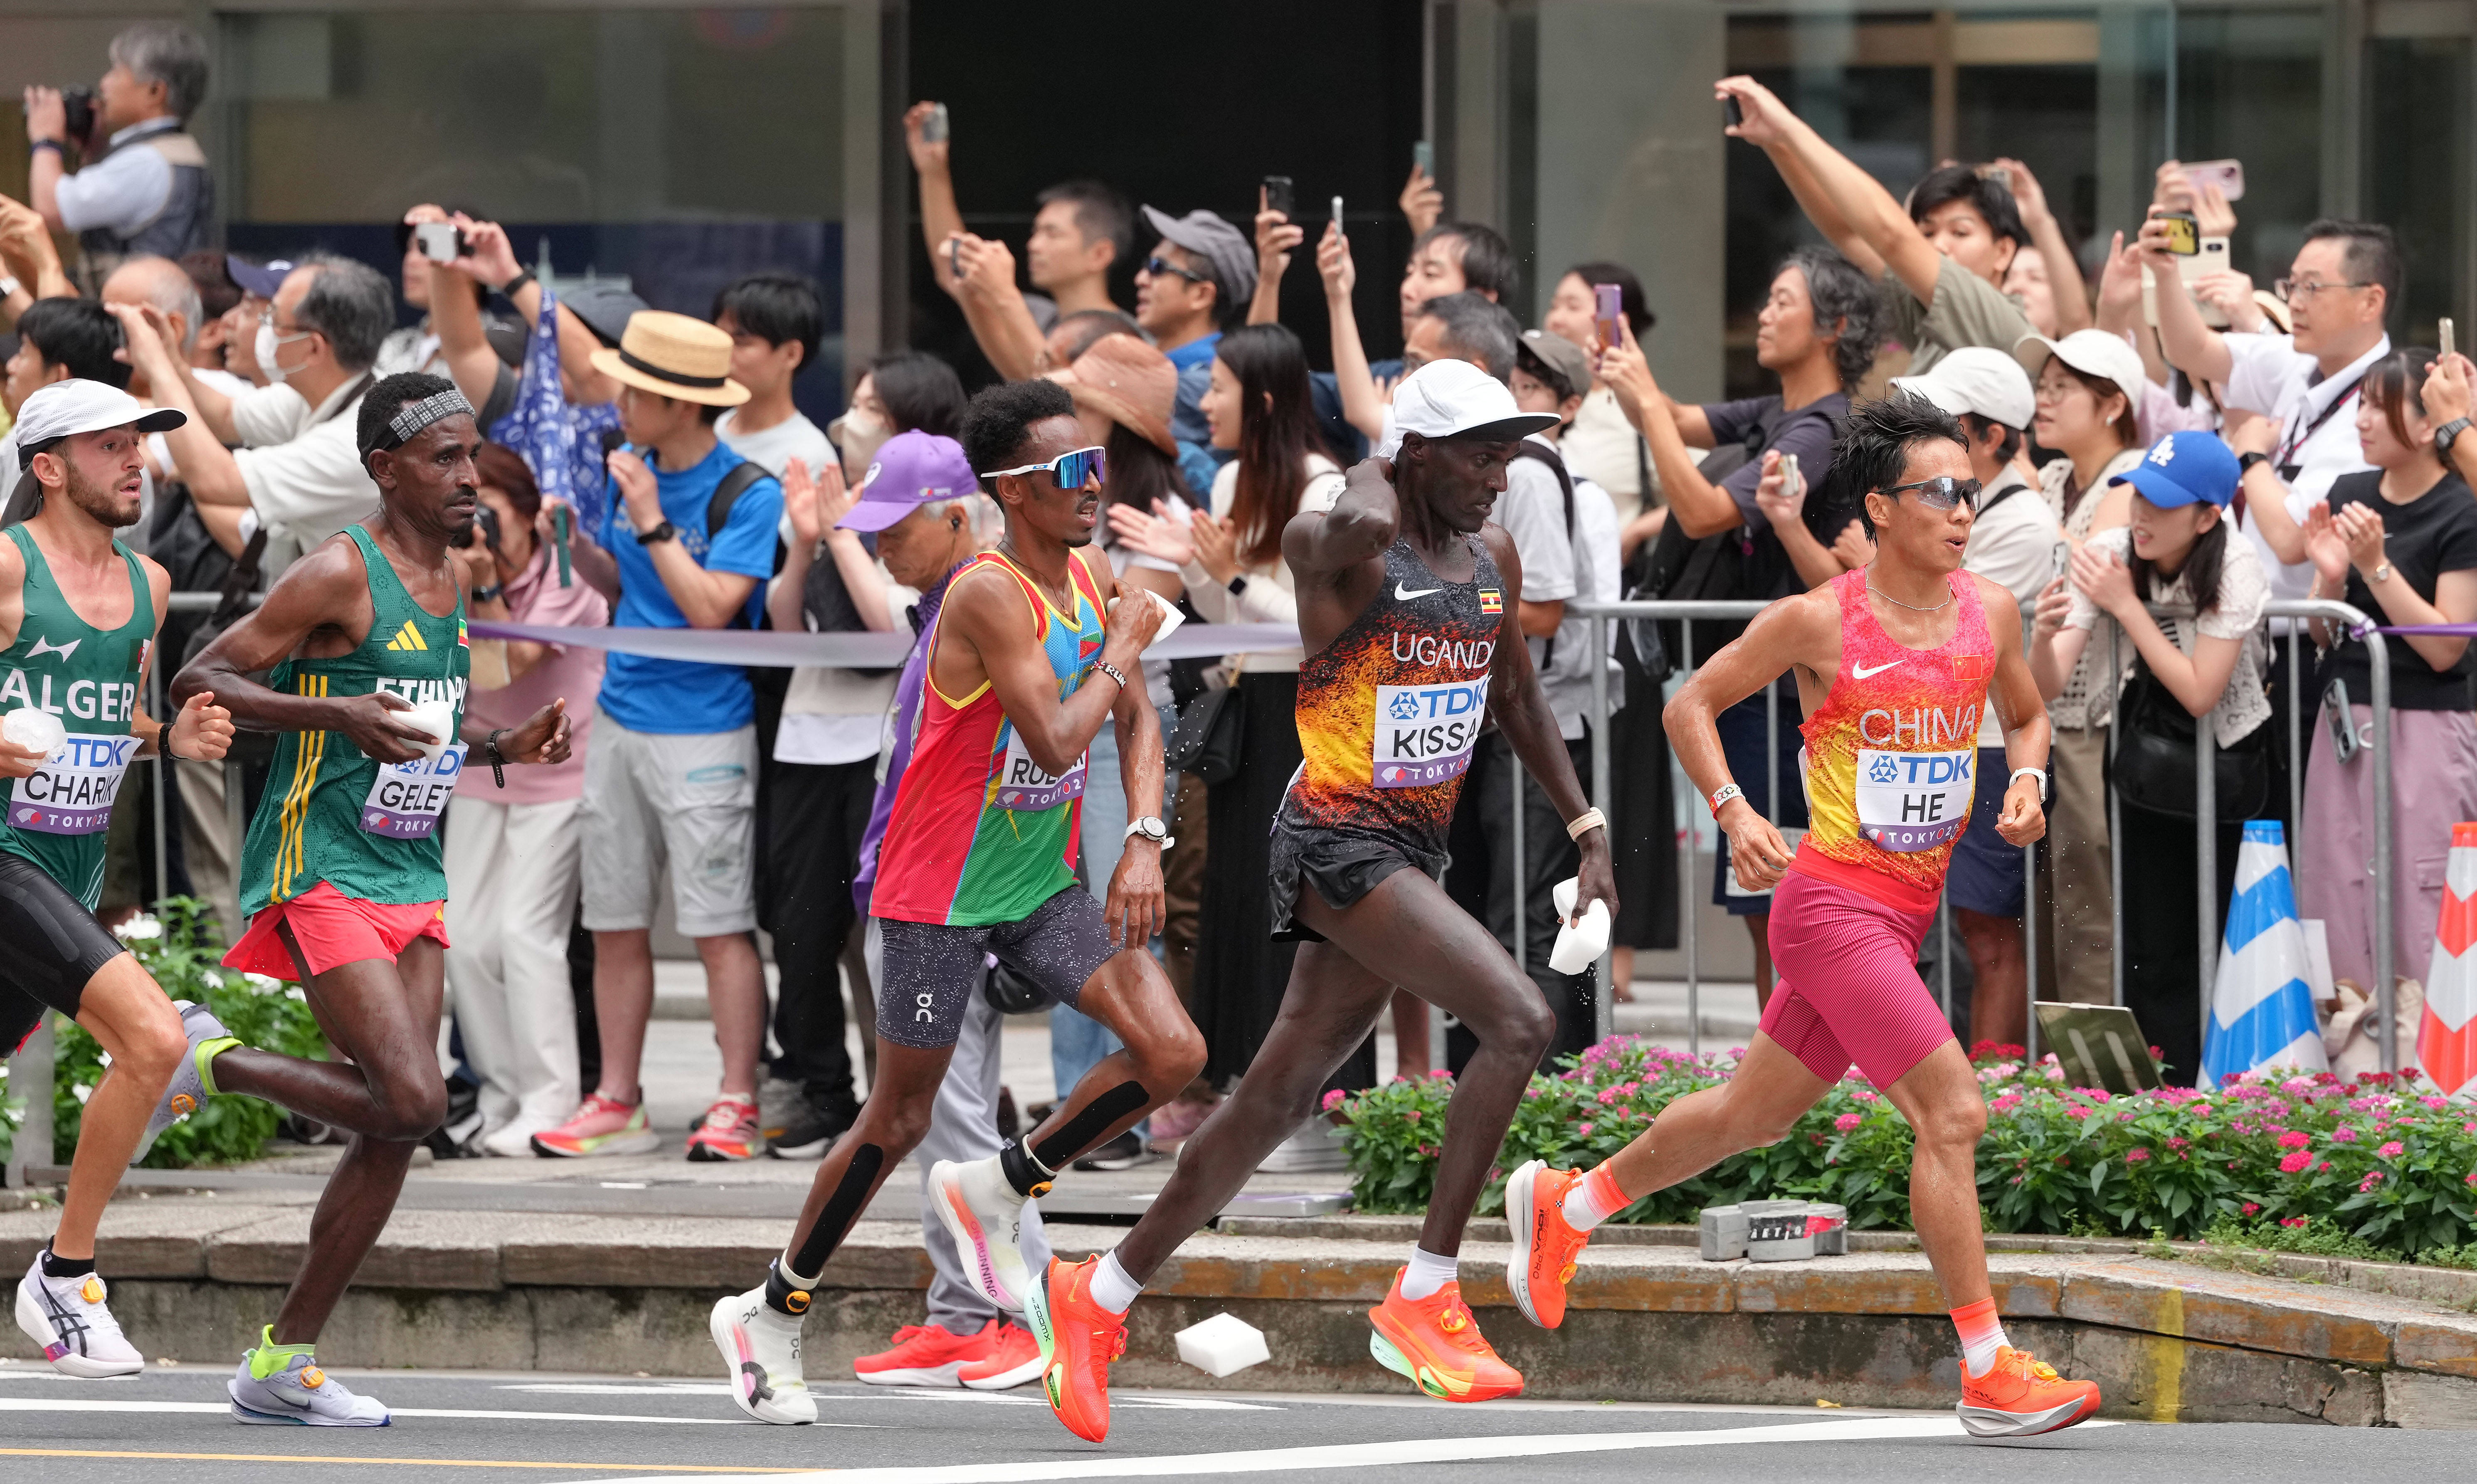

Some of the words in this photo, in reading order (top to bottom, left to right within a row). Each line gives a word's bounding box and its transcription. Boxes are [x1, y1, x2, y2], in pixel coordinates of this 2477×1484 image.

[1420, 679, 1487, 718] TDK
[1393, 717, 1475, 758] KISSA
[1859, 704, 1976, 745] CHINA
[67, 738, 133, 768] TDK
[1899, 753, 1972, 784] TDK
[25, 771, 119, 805] CHARIK
[1902, 793, 1946, 823] HE
[395, 820, 434, 832] TOKY
[977, 1242, 997, 1298] RUNNING
